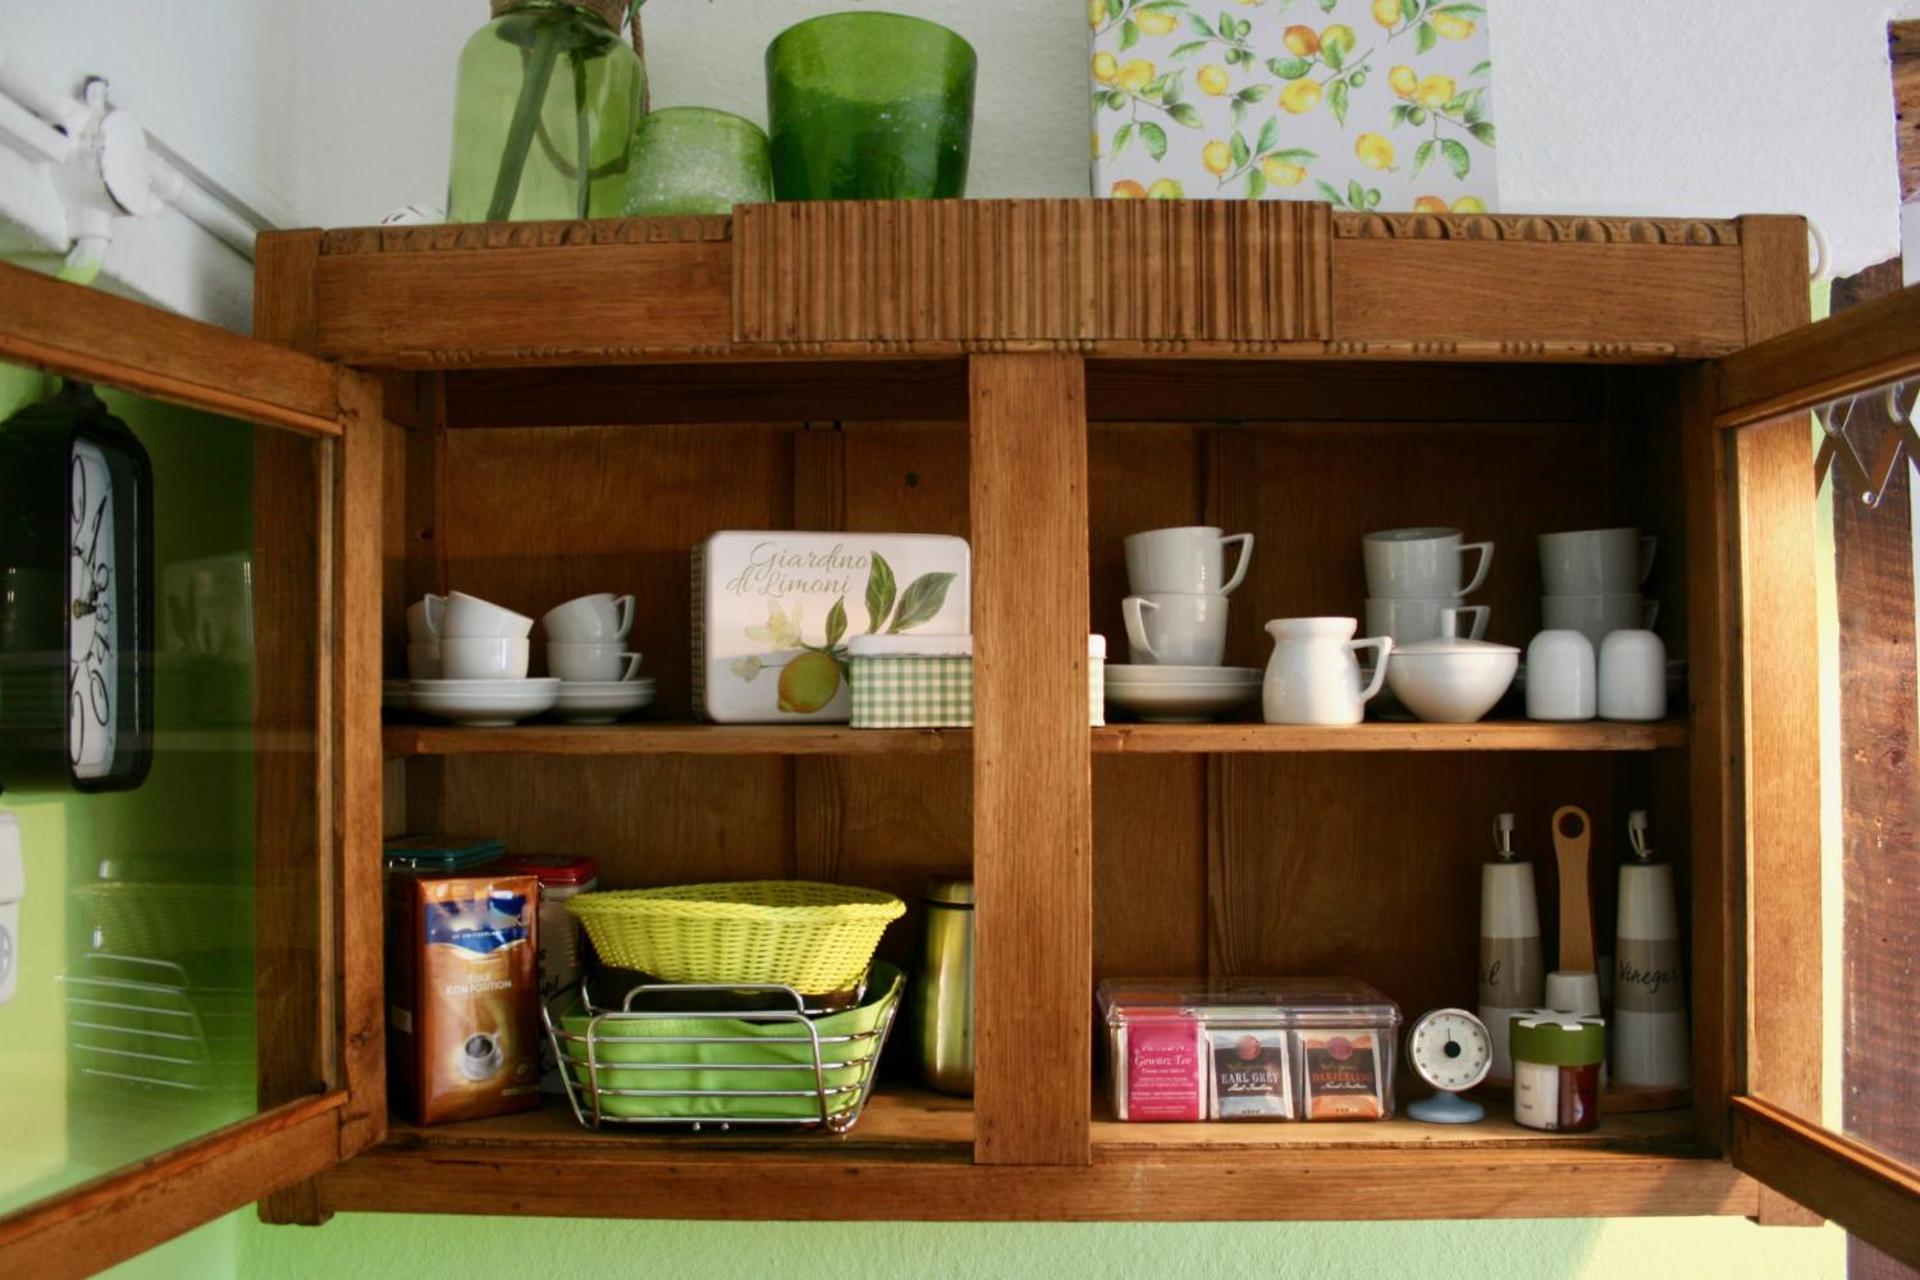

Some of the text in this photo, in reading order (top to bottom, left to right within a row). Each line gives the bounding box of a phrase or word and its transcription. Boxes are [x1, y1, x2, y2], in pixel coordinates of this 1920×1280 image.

[749, 541, 867, 581] Giardino
[726, 565, 850, 598] di Limoni
[1221, 1071, 1280, 1085] EARL GREY
